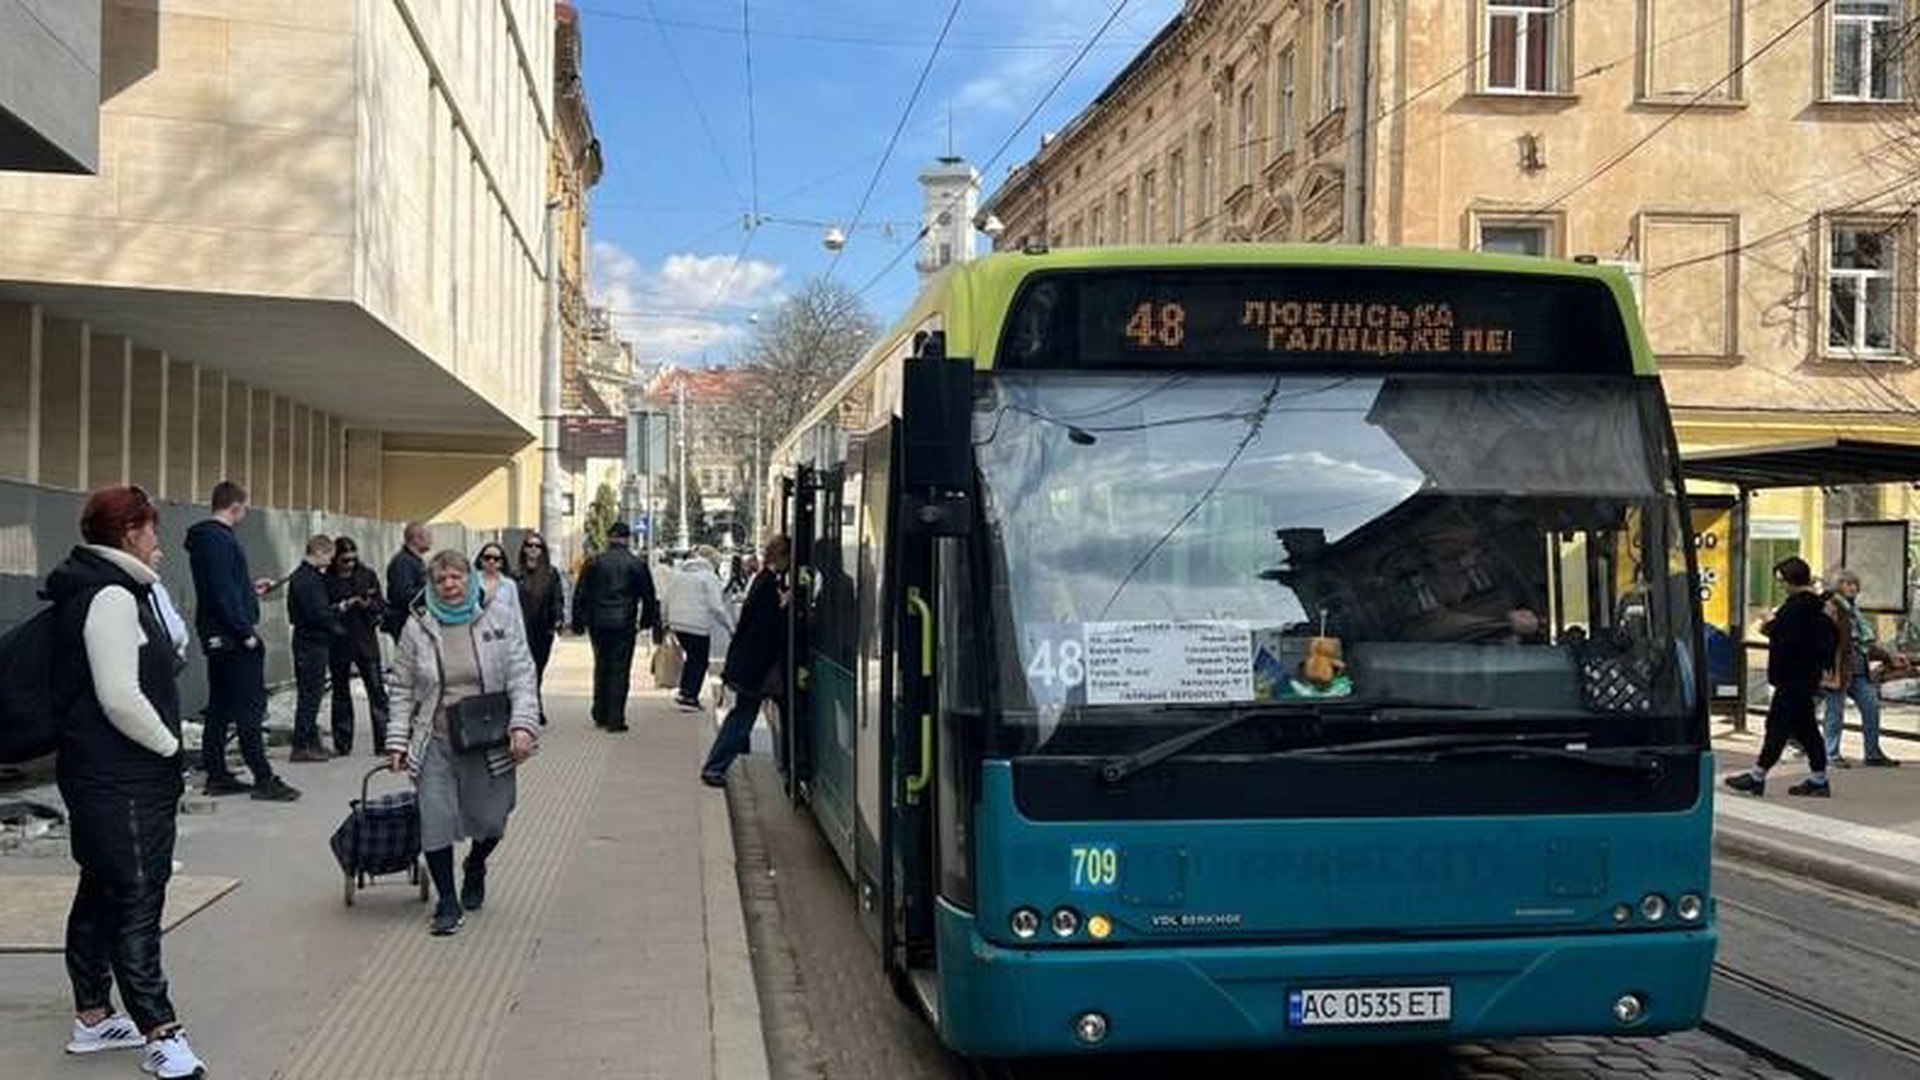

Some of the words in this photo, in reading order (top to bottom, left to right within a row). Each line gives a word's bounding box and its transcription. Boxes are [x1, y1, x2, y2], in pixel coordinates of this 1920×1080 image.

[1126, 303, 1185, 346] 48
[1243, 301, 1453, 328] ЛЮБІНСЬКА
[1267, 328, 1450, 355] ГАЛИЦЬКЕ
[1028, 640, 1084, 687] 48
[1072, 848, 1117, 885] 709
[1303, 993, 1338, 1019] AC
[1344, 992, 1402, 1018] 0535
[1408, 991, 1444, 1016] ET
